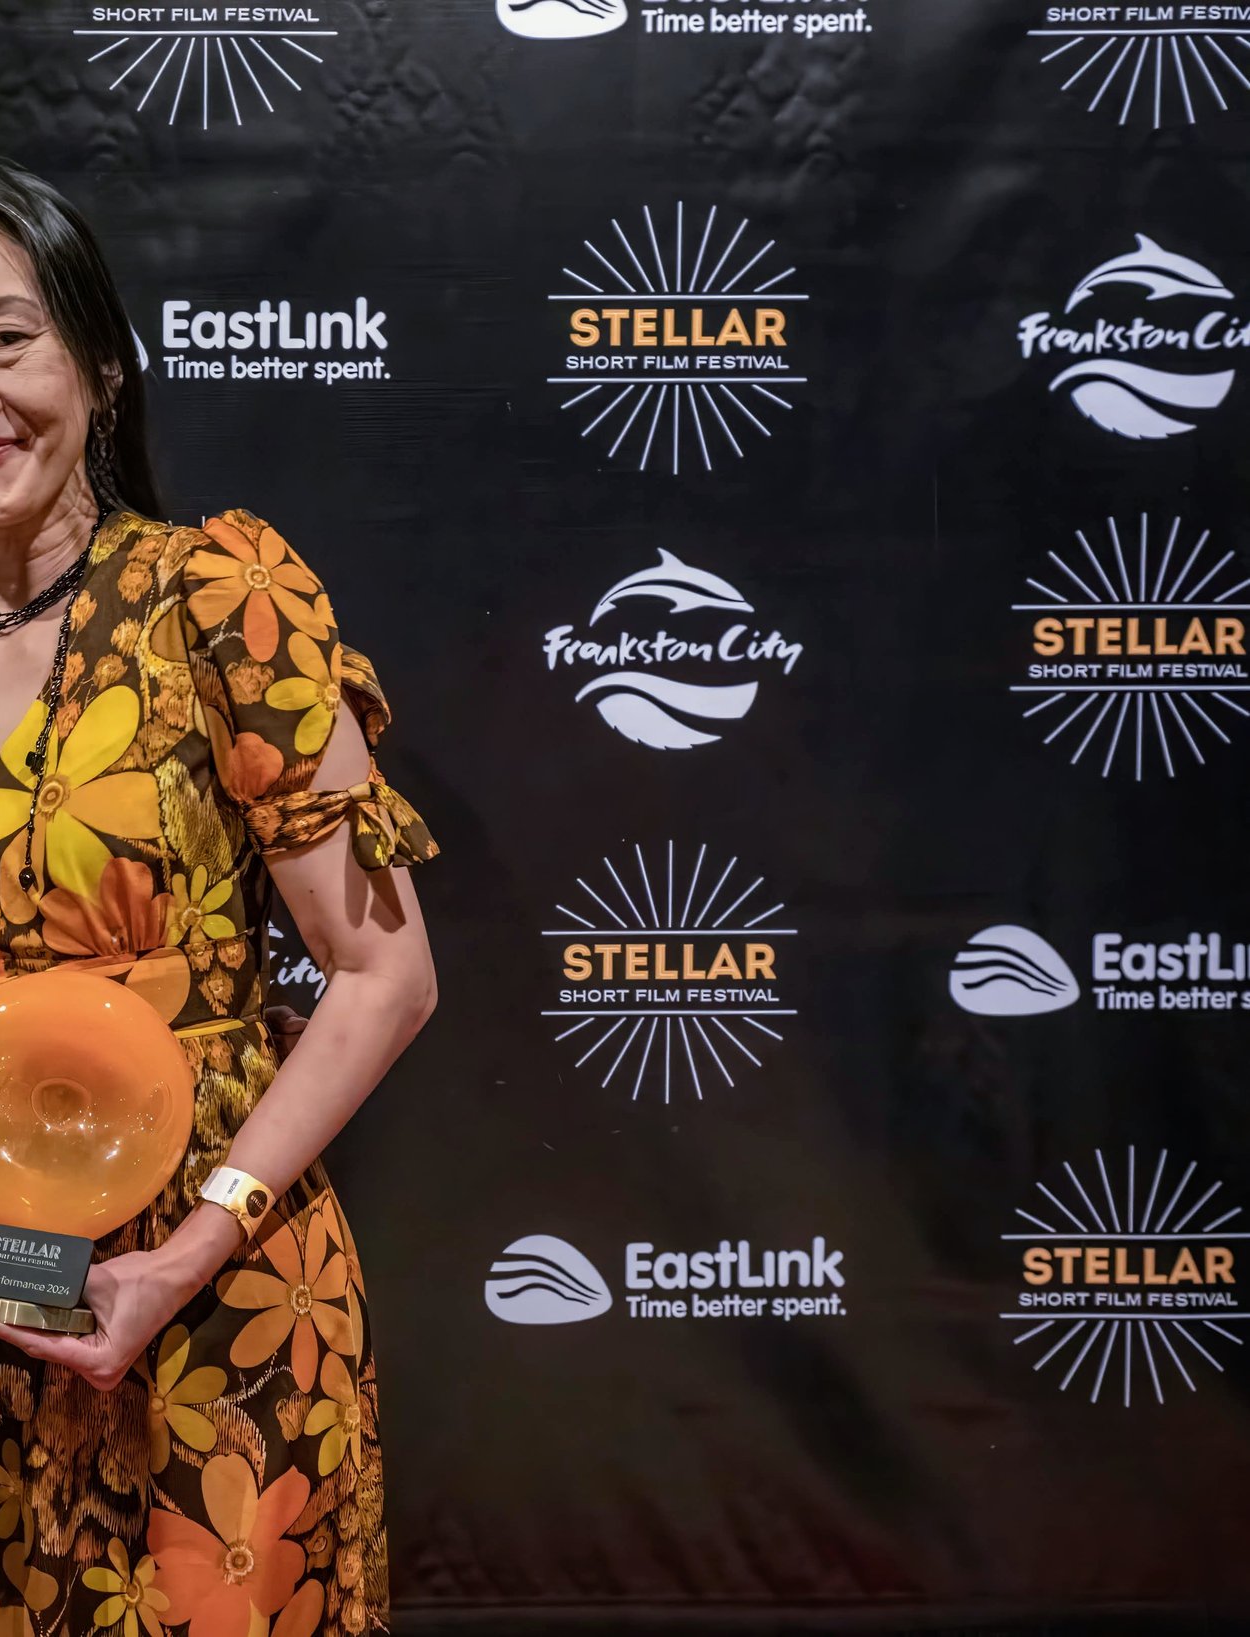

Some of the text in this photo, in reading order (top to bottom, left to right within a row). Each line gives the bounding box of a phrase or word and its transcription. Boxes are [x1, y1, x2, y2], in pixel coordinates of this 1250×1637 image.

[93, 7, 319, 21] SHORT FILM FESTIVAL
[641, 7, 872, 39] Time better spent.
[1047, 6, 1250, 22] SHORT FILM FESTIV
[162, 296, 389, 350] EastLink
[569, 307, 787, 348] STELLAR
[1017, 311, 1189, 359] Frankston
[163, 354, 391, 385] Time better spent.
[565, 355, 789, 370] SHORT FILM FESTIVAL
[543, 623, 804, 675] Frankston City
[1033, 616, 1247, 656] STELLAR
[1029, 663, 1248, 679] SHORT FILM FESTIVAL
[562, 942, 777, 982] STELLAR
[1092, 932, 1250, 981] EastLi
[269, 951, 327, 1000] ity
[559, 988, 780, 1003] SHORT FILM FESTIVAL
[1092, 985, 1155, 1010] Time
[1159, 985, 1238, 1010] better
[12, 1255, 27, 1263] FILM
[28, 1257, 58, 1268] FESTIVAL
[625, 1236, 845, 1290] EastLink
[1022, 1247, 1236, 1285] STELLAR
[47, 1283, 70, 1295] 2024
[1019, 1292, 1238, 1307] SHORT FILM FESTIVAL
[626, 1293, 847, 1321] Time better spent.
